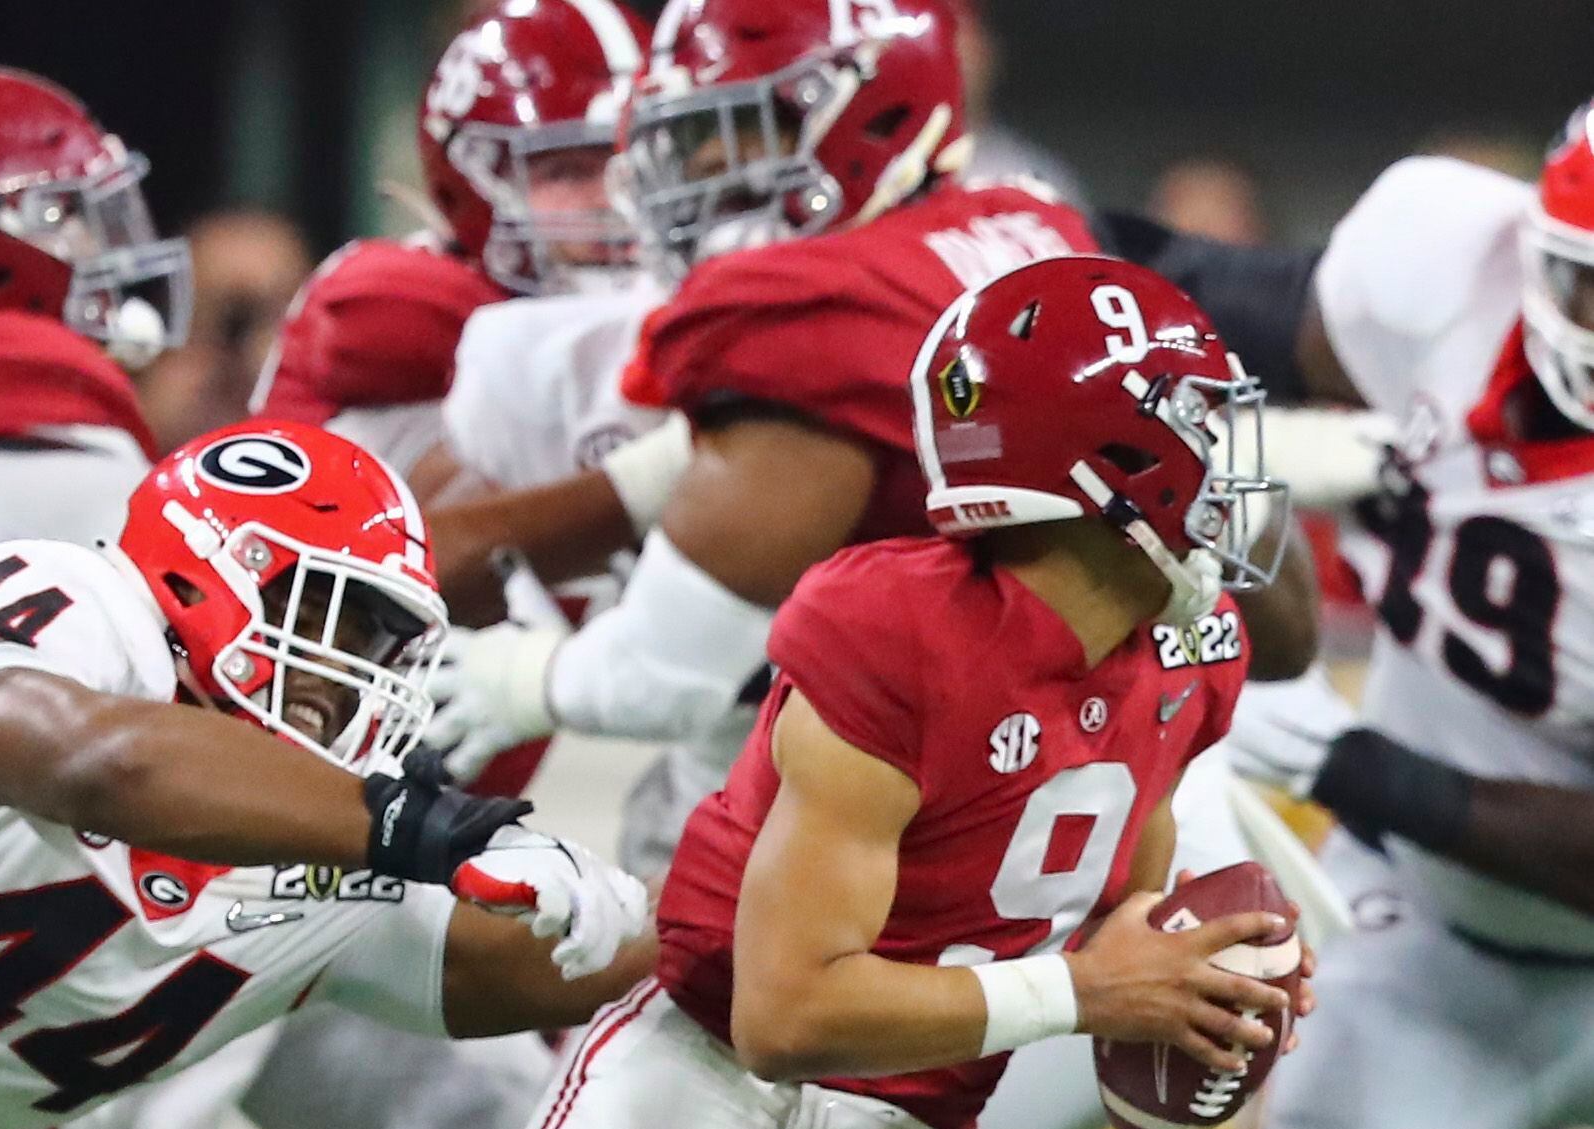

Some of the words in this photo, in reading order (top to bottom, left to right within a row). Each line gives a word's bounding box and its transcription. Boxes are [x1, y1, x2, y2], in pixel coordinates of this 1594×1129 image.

[1090, 284, 1149, 363] 9
[202, 438, 308, 487] G
[988, 711, 1043, 774] SEC
[141, 872, 189, 906] G
[936, 761, 1138, 968] 9
